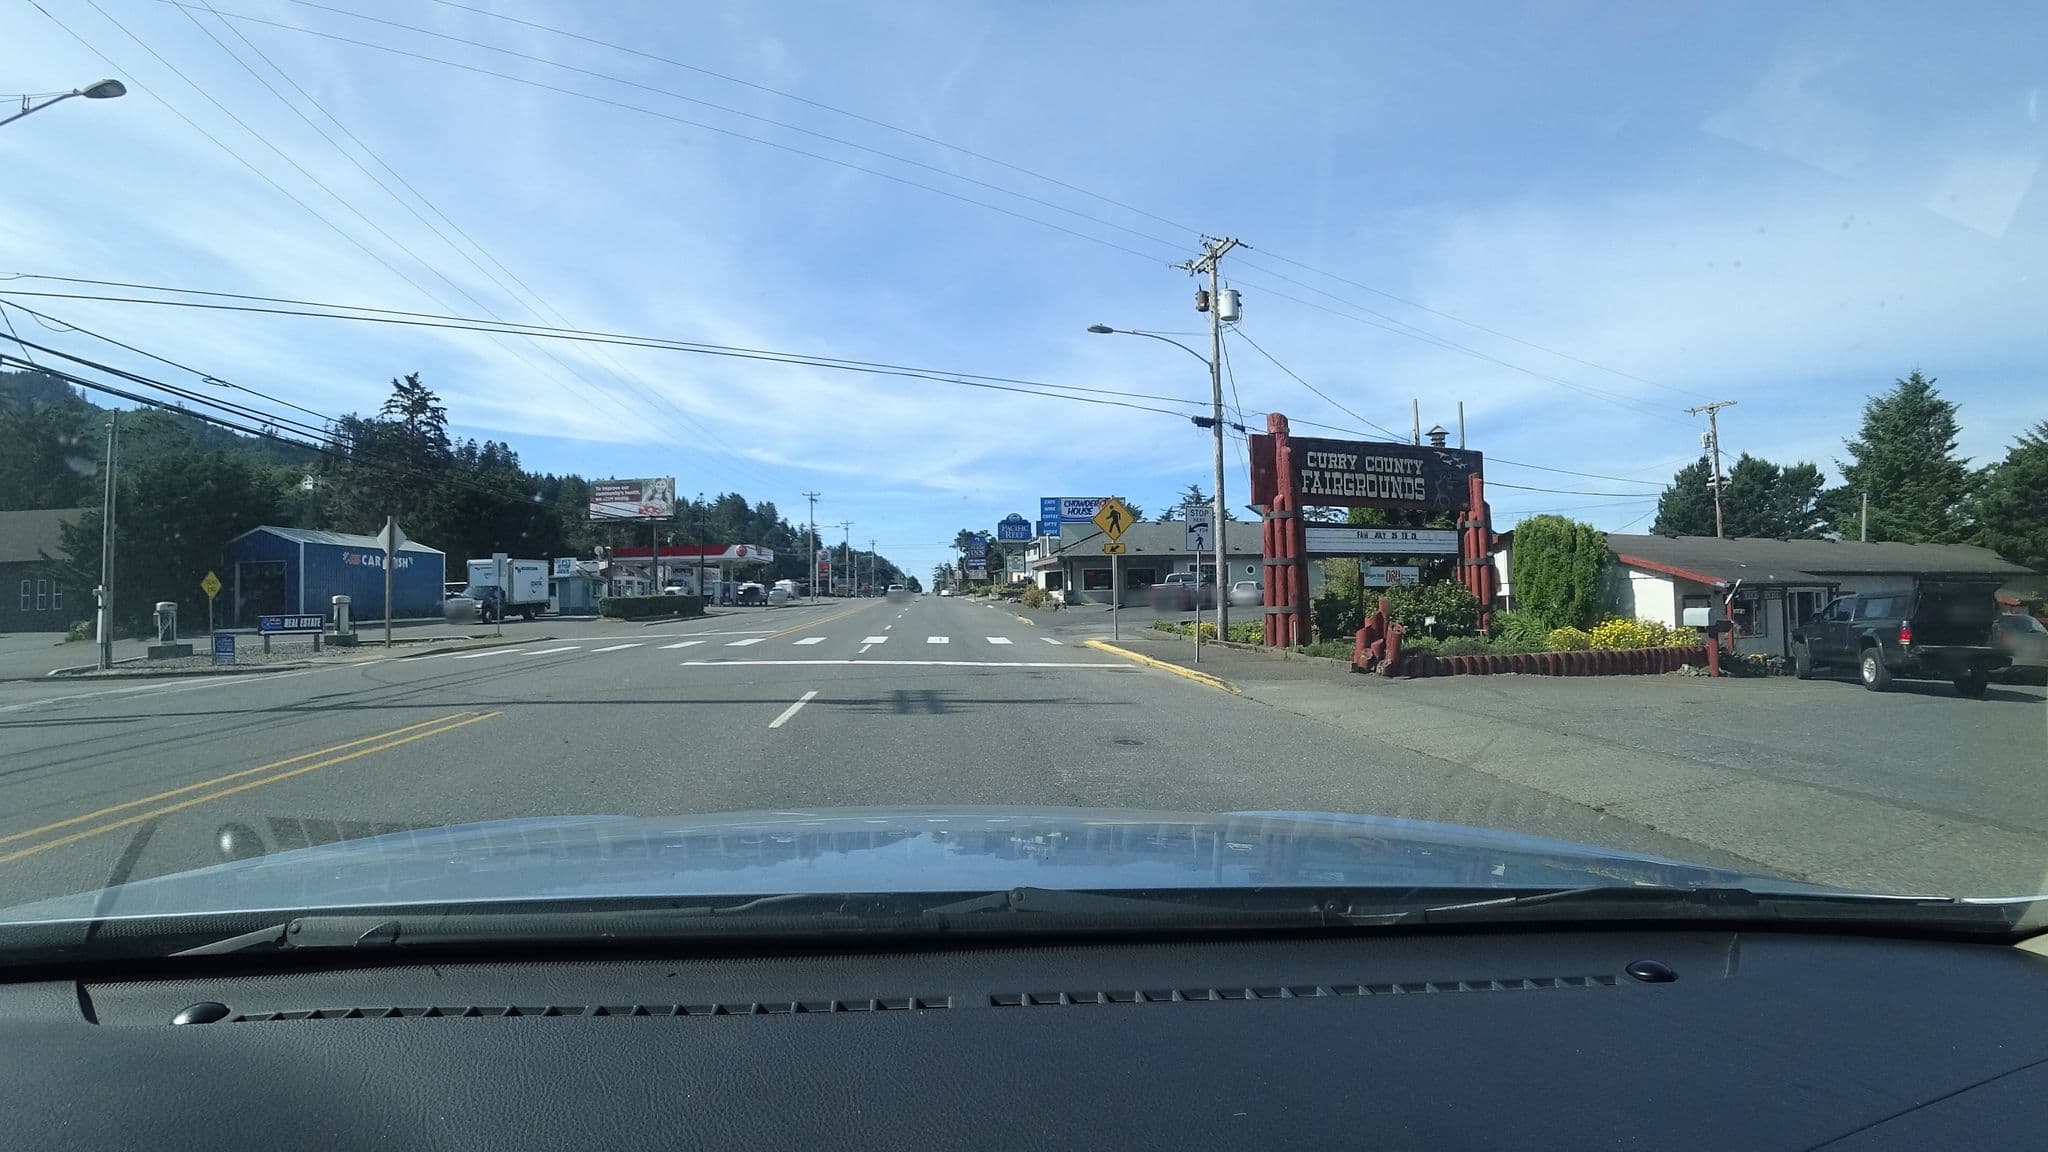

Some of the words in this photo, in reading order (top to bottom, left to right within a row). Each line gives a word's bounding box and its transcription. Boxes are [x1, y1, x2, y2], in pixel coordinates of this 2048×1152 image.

[1307, 451, 1358, 470] CURRY
[1365, 455, 1424, 475] COUNTY
[1301, 469, 1426, 501] FAIRGROUNDS
[1064, 499, 1099, 508] CHOWDER
[1067, 507, 1094, 516] HOUSE
[1190, 509, 1209, 517] STOP
[1001, 523, 1029, 532] PACIFIC
[1374, 531, 1386, 539] JULY
[361, 554, 381, 567] CAR
[283, 618, 298, 628] REAL
[299, 617, 321, 628] ESTATE
